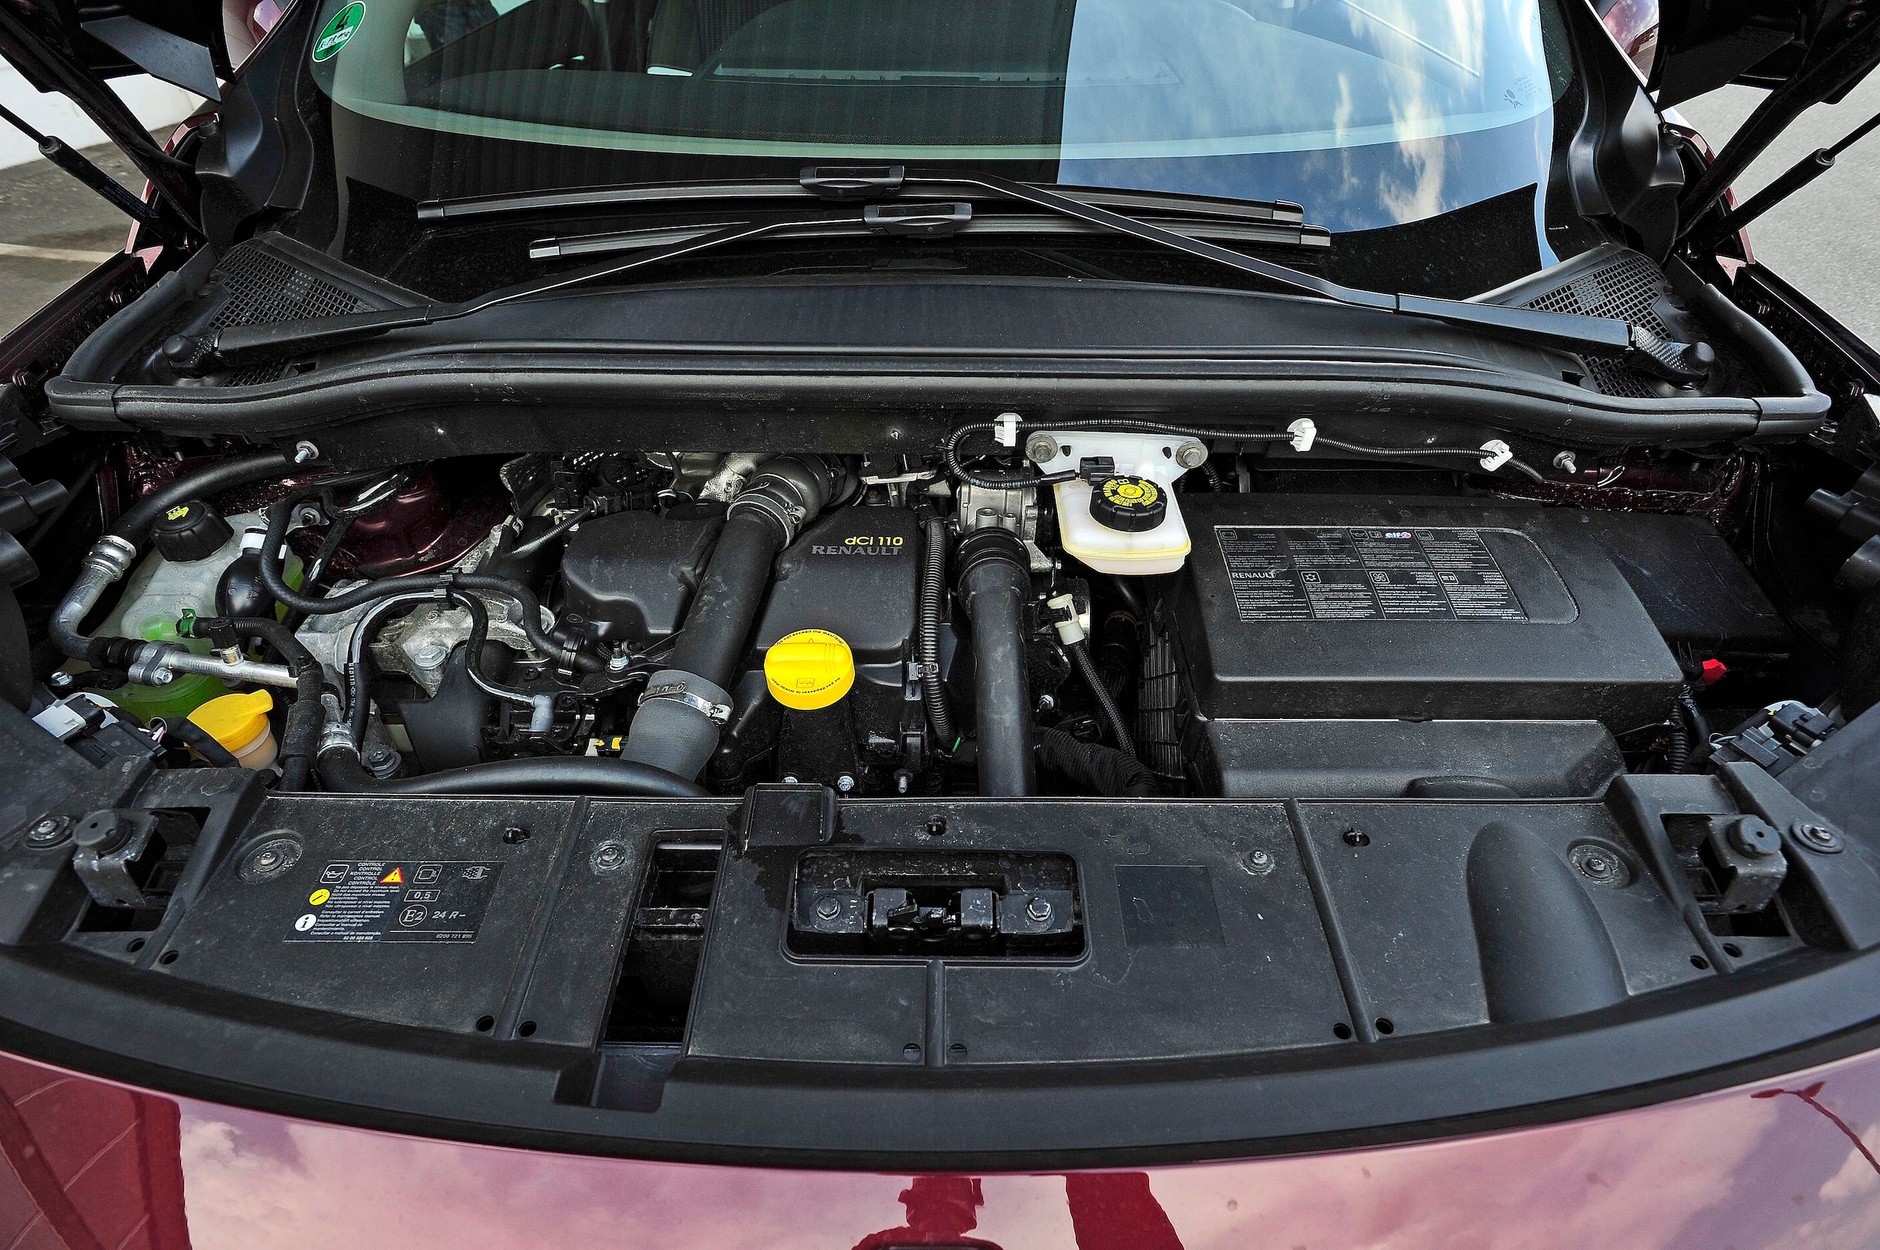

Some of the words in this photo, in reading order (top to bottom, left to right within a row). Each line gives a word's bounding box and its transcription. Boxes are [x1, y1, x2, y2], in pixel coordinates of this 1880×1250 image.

[878, 536, 903, 546] 110
[812, 545, 902, 555] RENAULT
[403, 910, 424, 922] E2
